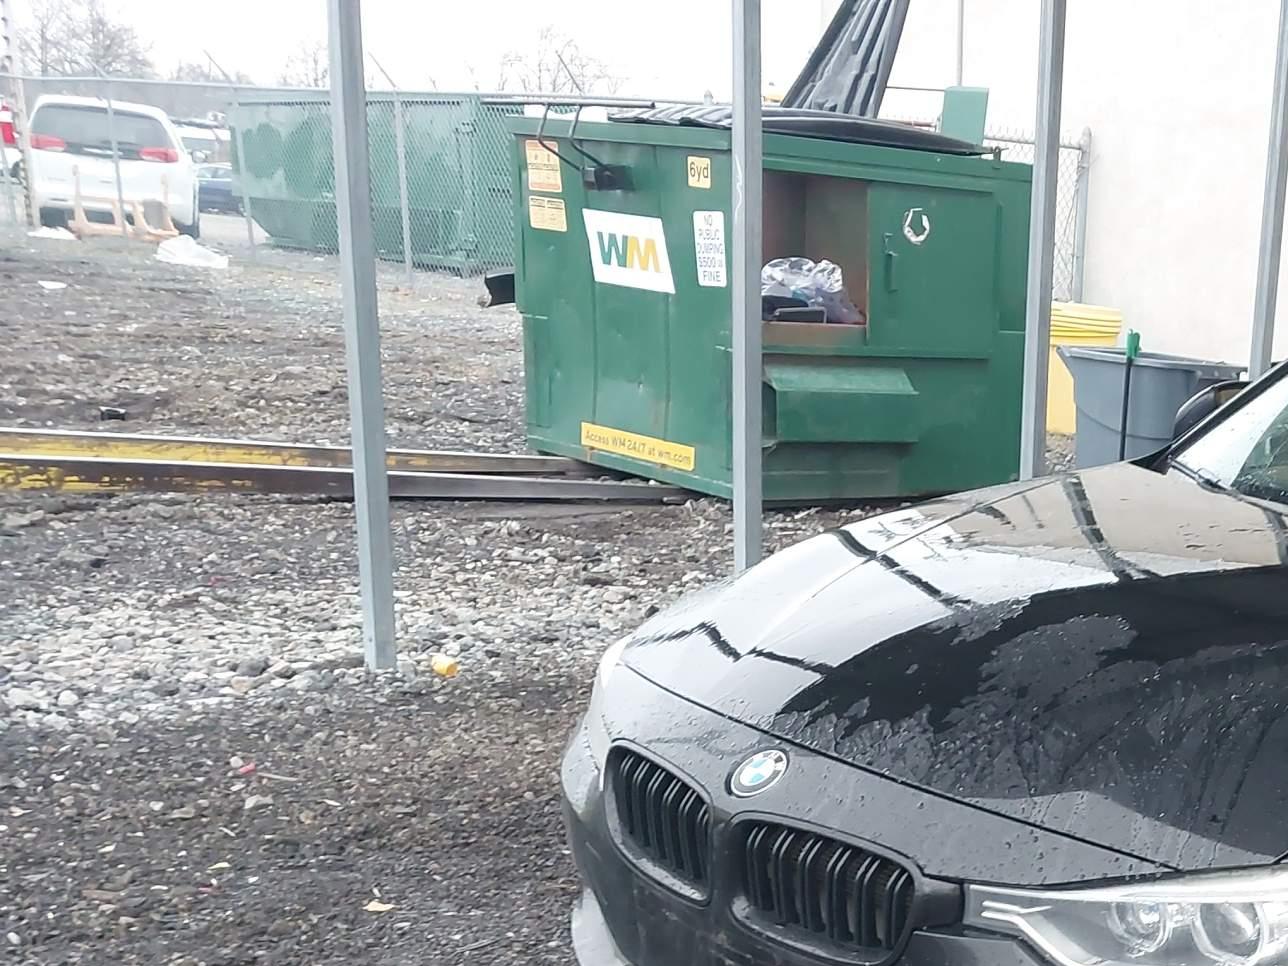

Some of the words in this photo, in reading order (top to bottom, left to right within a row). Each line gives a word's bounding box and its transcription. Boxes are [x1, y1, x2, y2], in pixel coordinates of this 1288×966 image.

[690, 161, 709, 182] 6yd
[597, 231, 662, 273] WM
[702, 270, 722, 282] FINE
[585, 430, 609, 446] Access
[611, 437, 626, 448] WM
[648, 447, 656, 456] at
[657, 451, 691, 465] wm.com
